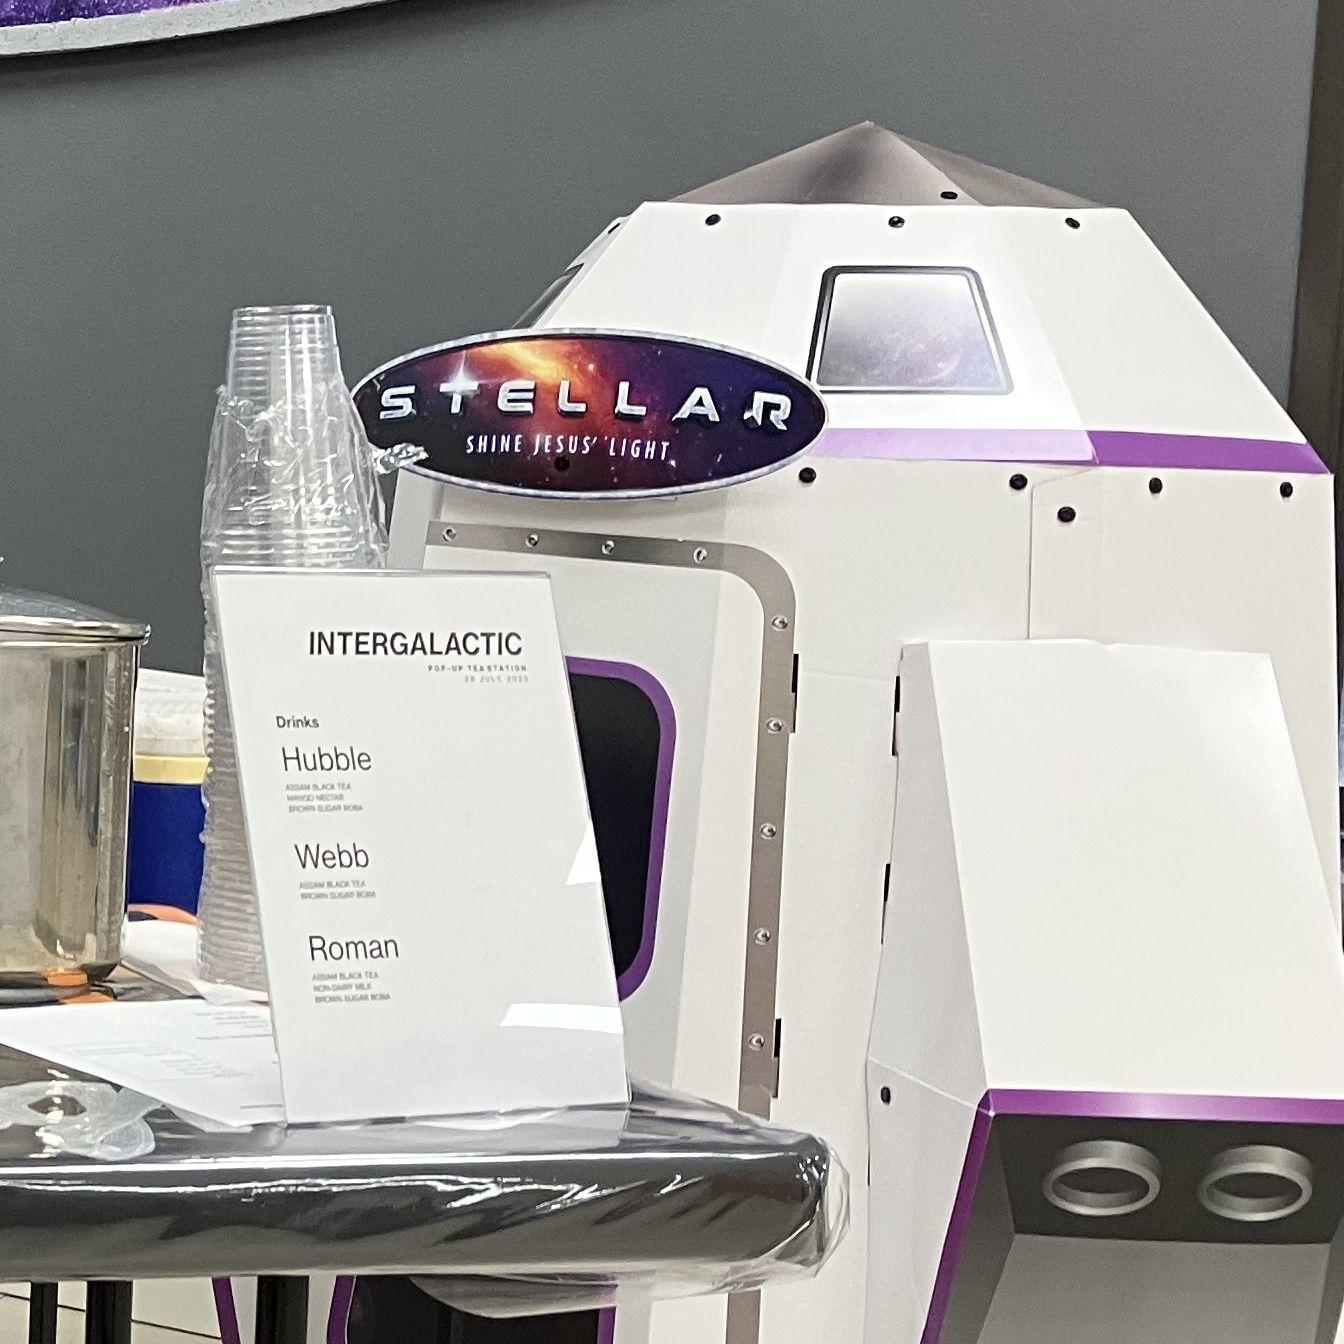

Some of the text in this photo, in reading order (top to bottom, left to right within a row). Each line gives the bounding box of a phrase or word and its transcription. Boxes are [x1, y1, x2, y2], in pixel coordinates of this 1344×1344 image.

[379, 379, 792, 431] STELLAR
[466, 434, 523, 455] SHINE
[609, 440, 670, 460] LIGHT
[310, 632, 522, 655] INTERGALACTIC
[276, 716, 319, 728] Drinks
[282, 746, 371, 771] Hubble
[294, 843, 369, 869] Webb
[309, 936, 398, 961] Roman
